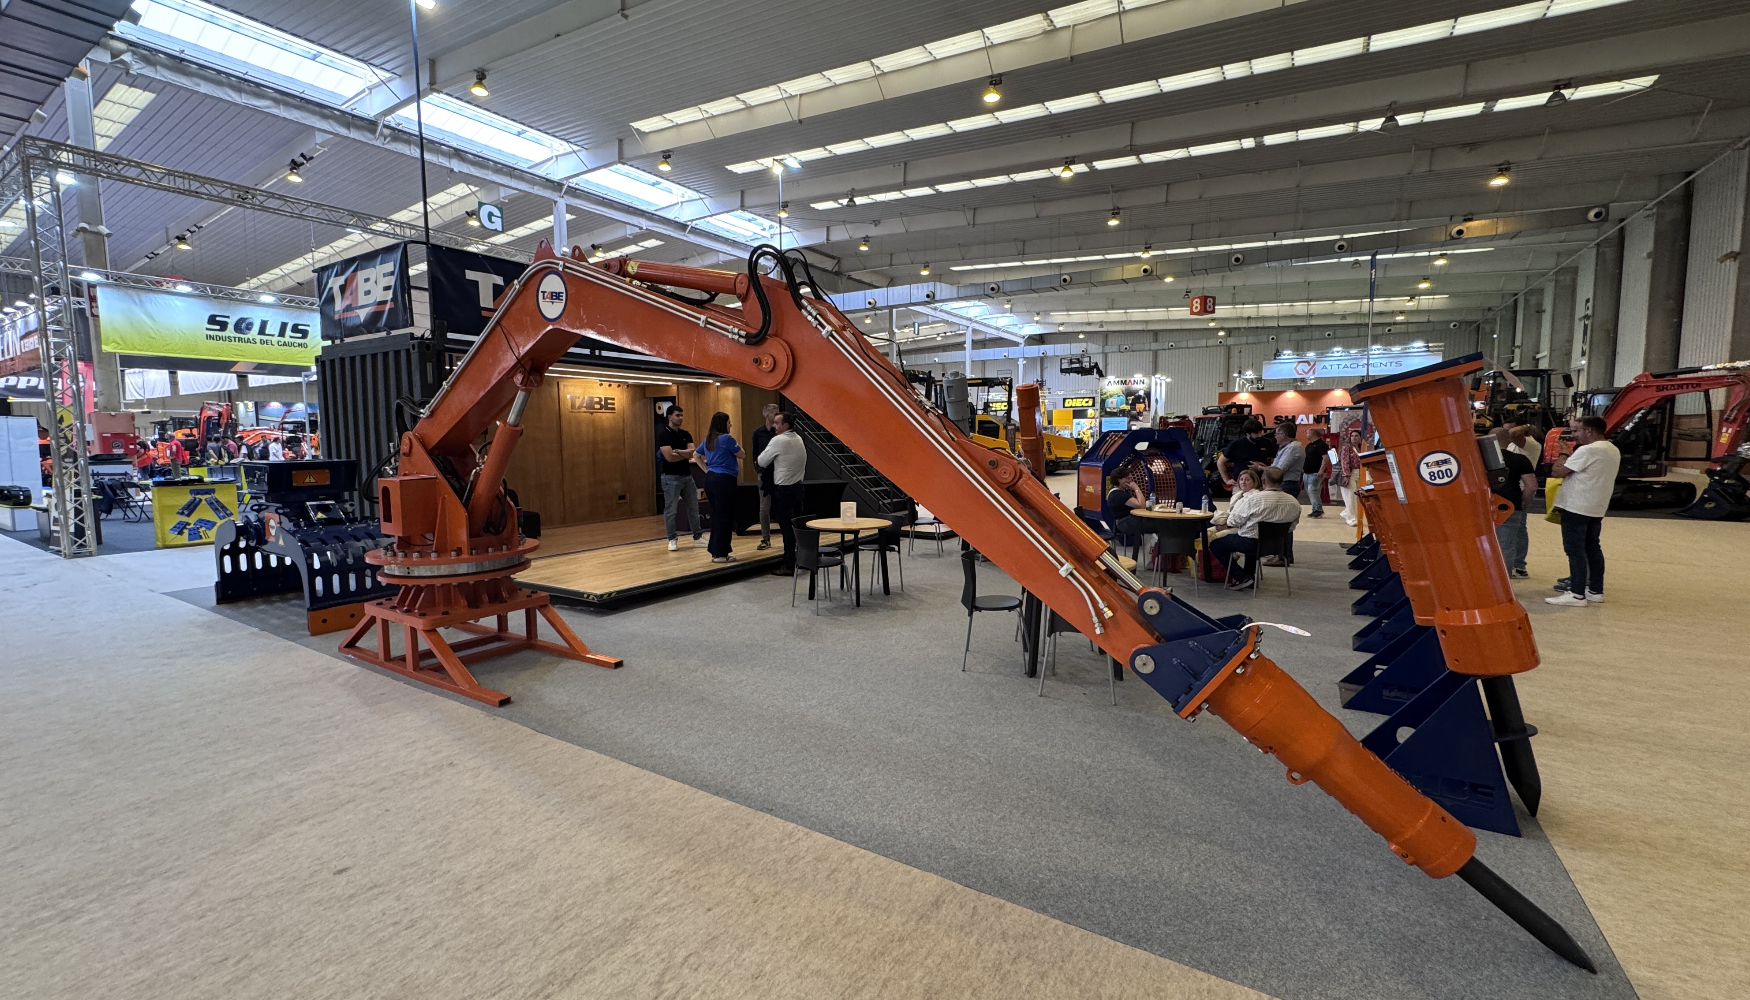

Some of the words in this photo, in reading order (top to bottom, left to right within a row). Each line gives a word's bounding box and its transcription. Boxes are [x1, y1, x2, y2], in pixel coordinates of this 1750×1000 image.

[479, 204, 502, 231] G
[328, 261, 394, 312] TABE
[540, 290, 564, 302] TABE
[1192, 298, 1201, 313] 8
[1206, 297, 1214, 312] 8
[205, 314, 310, 340] SOLIS
[205, 334, 257, 345] INDUSTRIAS
[277, 340, 308, 349] CAUCHO
[1320, 360, 1403, 371] ATTACHMENTS
[567, 395, 616, 411] TABE
[1423, 457, 1453, 468] TABE
[1428, 468, 1453, 482] 800
